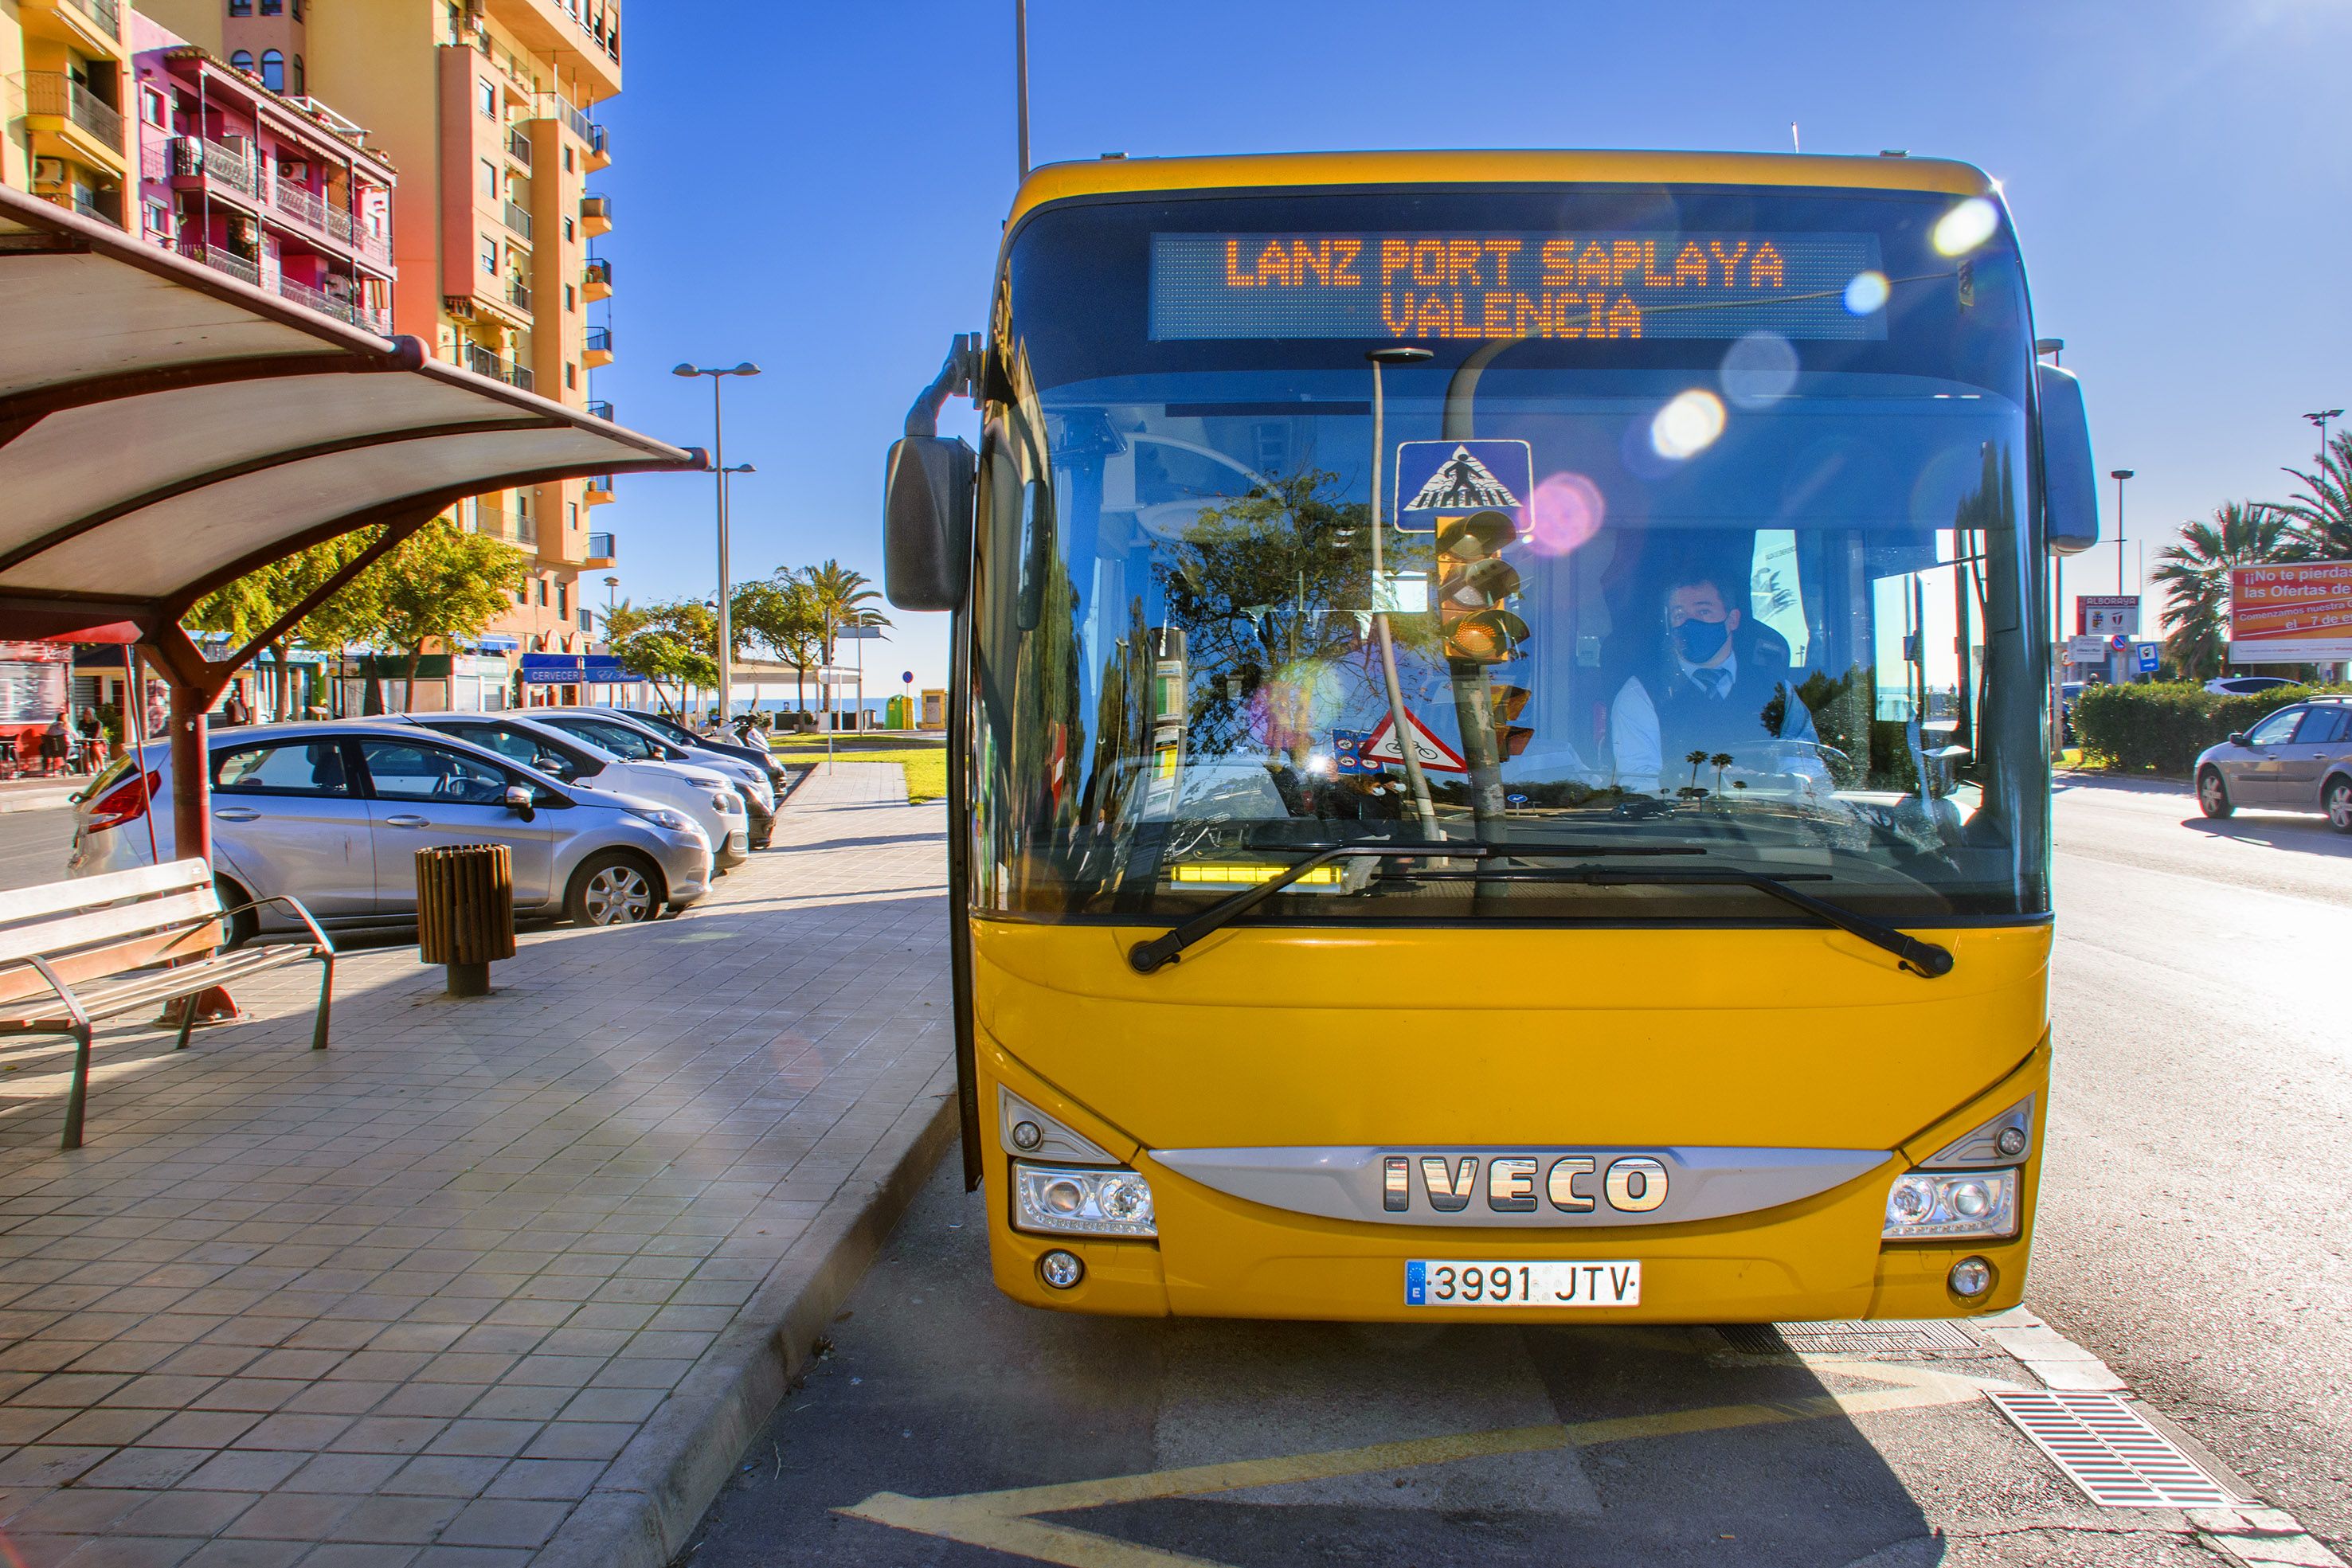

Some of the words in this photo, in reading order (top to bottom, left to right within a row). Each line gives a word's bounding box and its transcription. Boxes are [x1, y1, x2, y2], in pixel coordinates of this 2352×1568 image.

[1227, 240, 1361, 286] LANZ
[1383, 240, 1521, 286] PORT
[1543, 240, 1783, 287] SAPLAYA
[1383, 292, 1641, 338] VALENCIA
[2280, 569, 2295, 581] te
[2244, 587, 2266, 598] las
[2271, 585, 2327, 597] Ofertas
[2331, 583, 2351, 595] de
[2239, 607, 2305, 621] Comenzamos
[2307, 601, 2345, 613] nuestra
[2285, 619, 2298, 629] el
[2311, 616, 2319, 626] 7
[2322, 615, 2338, 624] de
[531, 671, 588, 681] CERVECERA
[1383, 1155, 1669, 1213] IVECO
[1434, 1266, 1530, 1301] 3991
[1555, 1266, 1631, 1300] JTV
[1411, 1287, 1421, 1298] E
